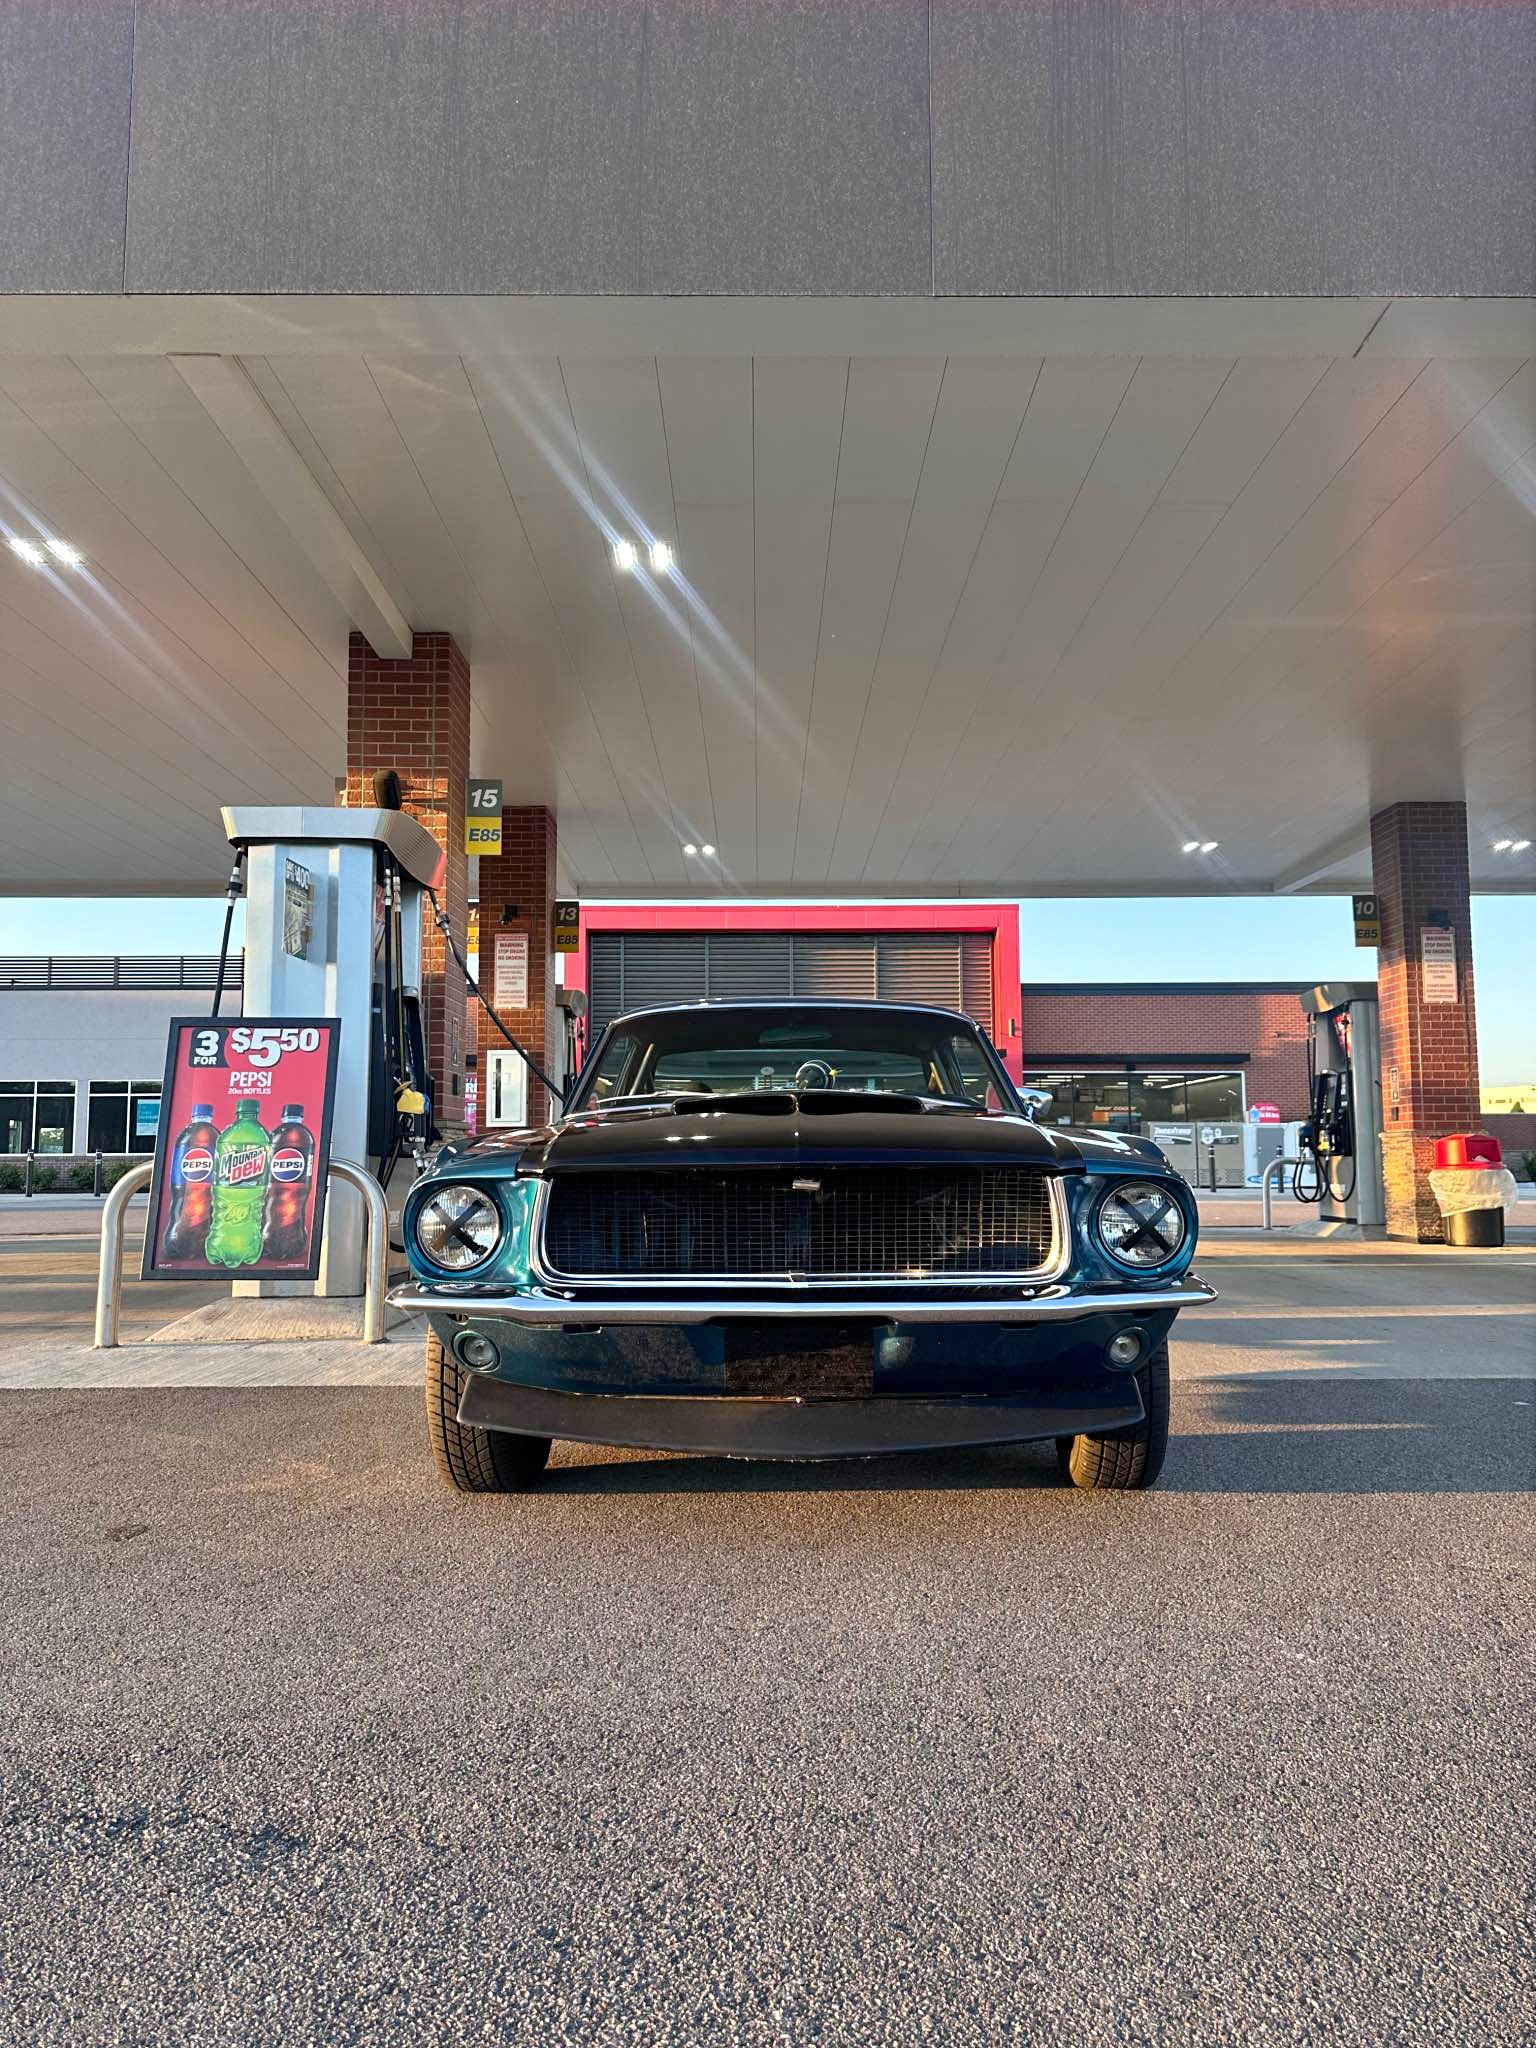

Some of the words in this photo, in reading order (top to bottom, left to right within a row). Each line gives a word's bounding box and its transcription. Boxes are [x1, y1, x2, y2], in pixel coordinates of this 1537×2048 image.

[471, 788, 498, 808] 15
[469, 828, 501, 842] E85
[558, 907, 577, 921] 13
[1355, 901, 1374, 915] 10
[557, 935, 577, 944] E85
[195, 1030, 220, 1057] 3
[193, 1056, 217, 1066] FOR
[229, 1071, 273, 1088] PEPSI
[243, 1087, 272, 1095] BOTTLES
[182, 1161, 212, 1169] PEPSI
[272, 1161, 303, 1169] PEPSI
